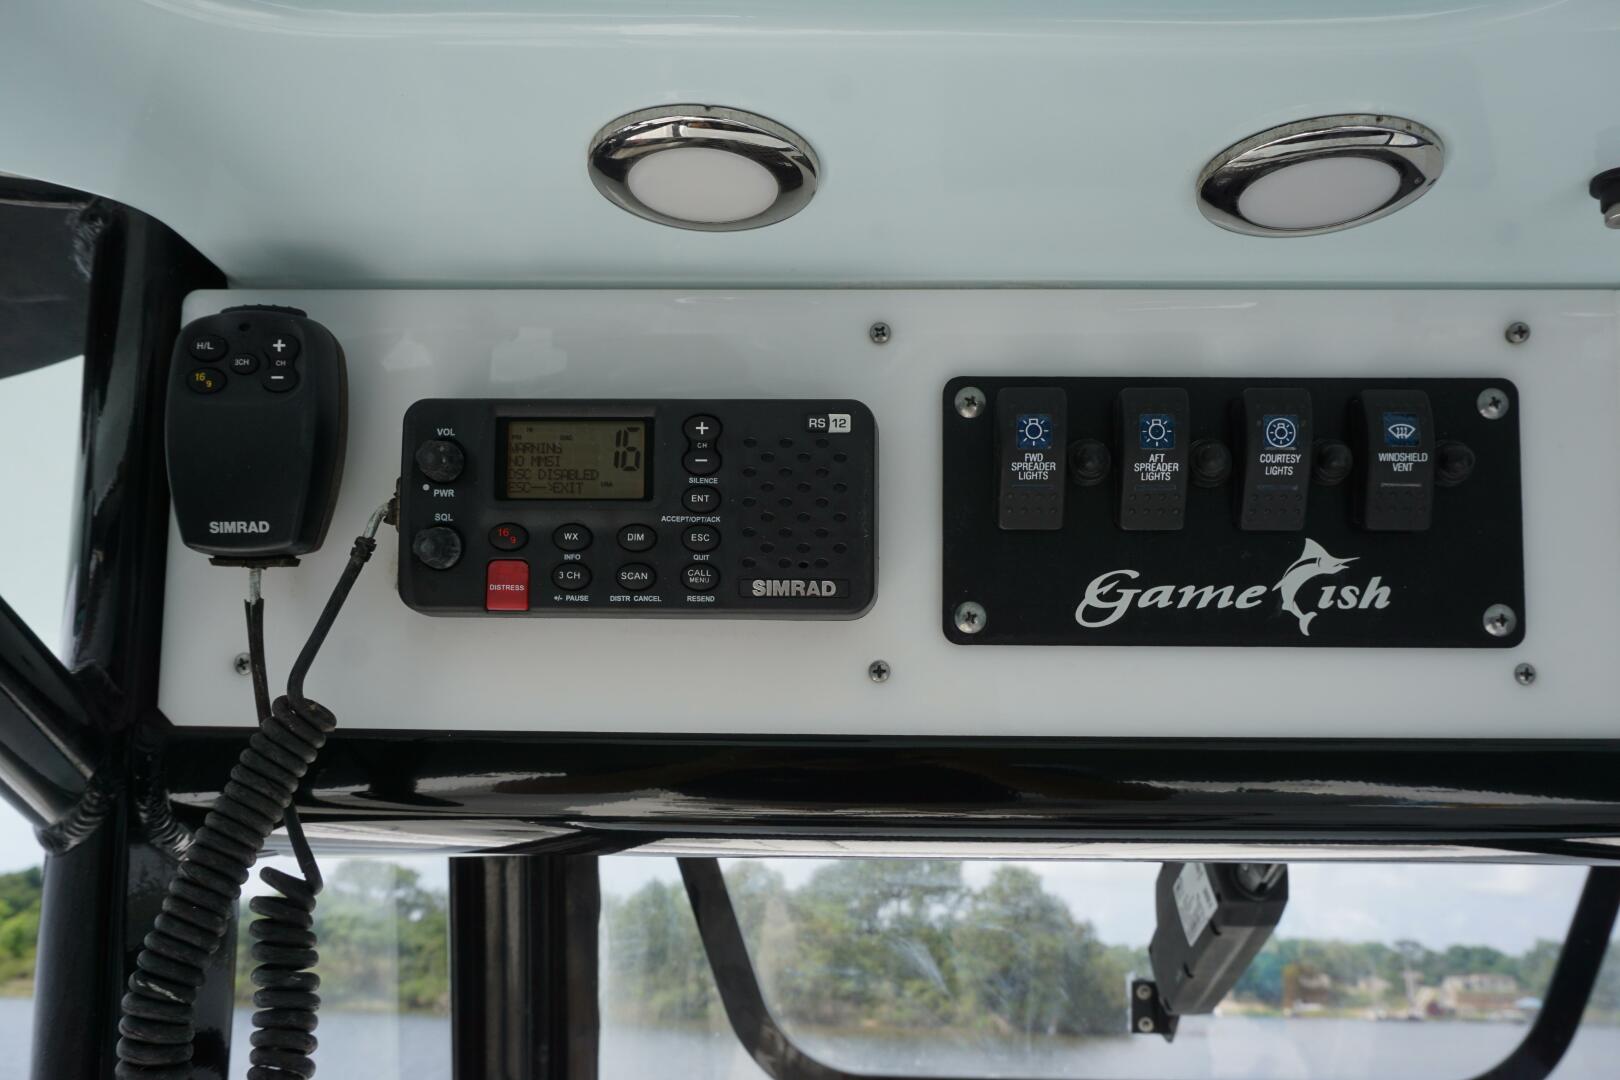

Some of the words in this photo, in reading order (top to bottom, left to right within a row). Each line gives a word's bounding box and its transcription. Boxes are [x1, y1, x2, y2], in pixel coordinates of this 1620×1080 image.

[196, 342, 215, 350] H/L
[275, 359, 287, 367] CH
[436, 427, 456, 436] VOL
[613, 426, 641, 472] 16
[530, 455, 561, 467] MMSI
[1024, 453, 1044, 462] FWD
[1149, 453, 1165, 463] AFT
[1259, 453, 1301, 463] COURTESY
[1378, 453, 1428, 462] WINDSHIELD
[1011, 462, 1056, 471] SPREADER
[1133, 463, 1179, 472] SPREADER
[1265, 466, 1294, 476] LIGHTS
[1392, 463, 1413, 472] VENT
[538, 468, 600, 480] DISABLED
[1018, 471, 1049, 480] LIGHTS
[1140, 472, 1171, 481] LIGHTS
[433, 489, 455, 497] PWR
[691, 494, 710, 502] ENT
[434, 513, 454, 522] SQL
[661, 515, 721, 523] ACCEPT/OPT/ACK
[209, 520, 270, 534] SIMRAD
[498, 528, 510, 537] 16
[563, 532, 579, 541] WX
[627, 533, 645, 541] DIM
[691, 533, 710, 542] ESC
[620, 572, 648, 580] SCAN
[687, 569, 712, 577] CALL
[751, 579, 837, 597] SIMRAD
